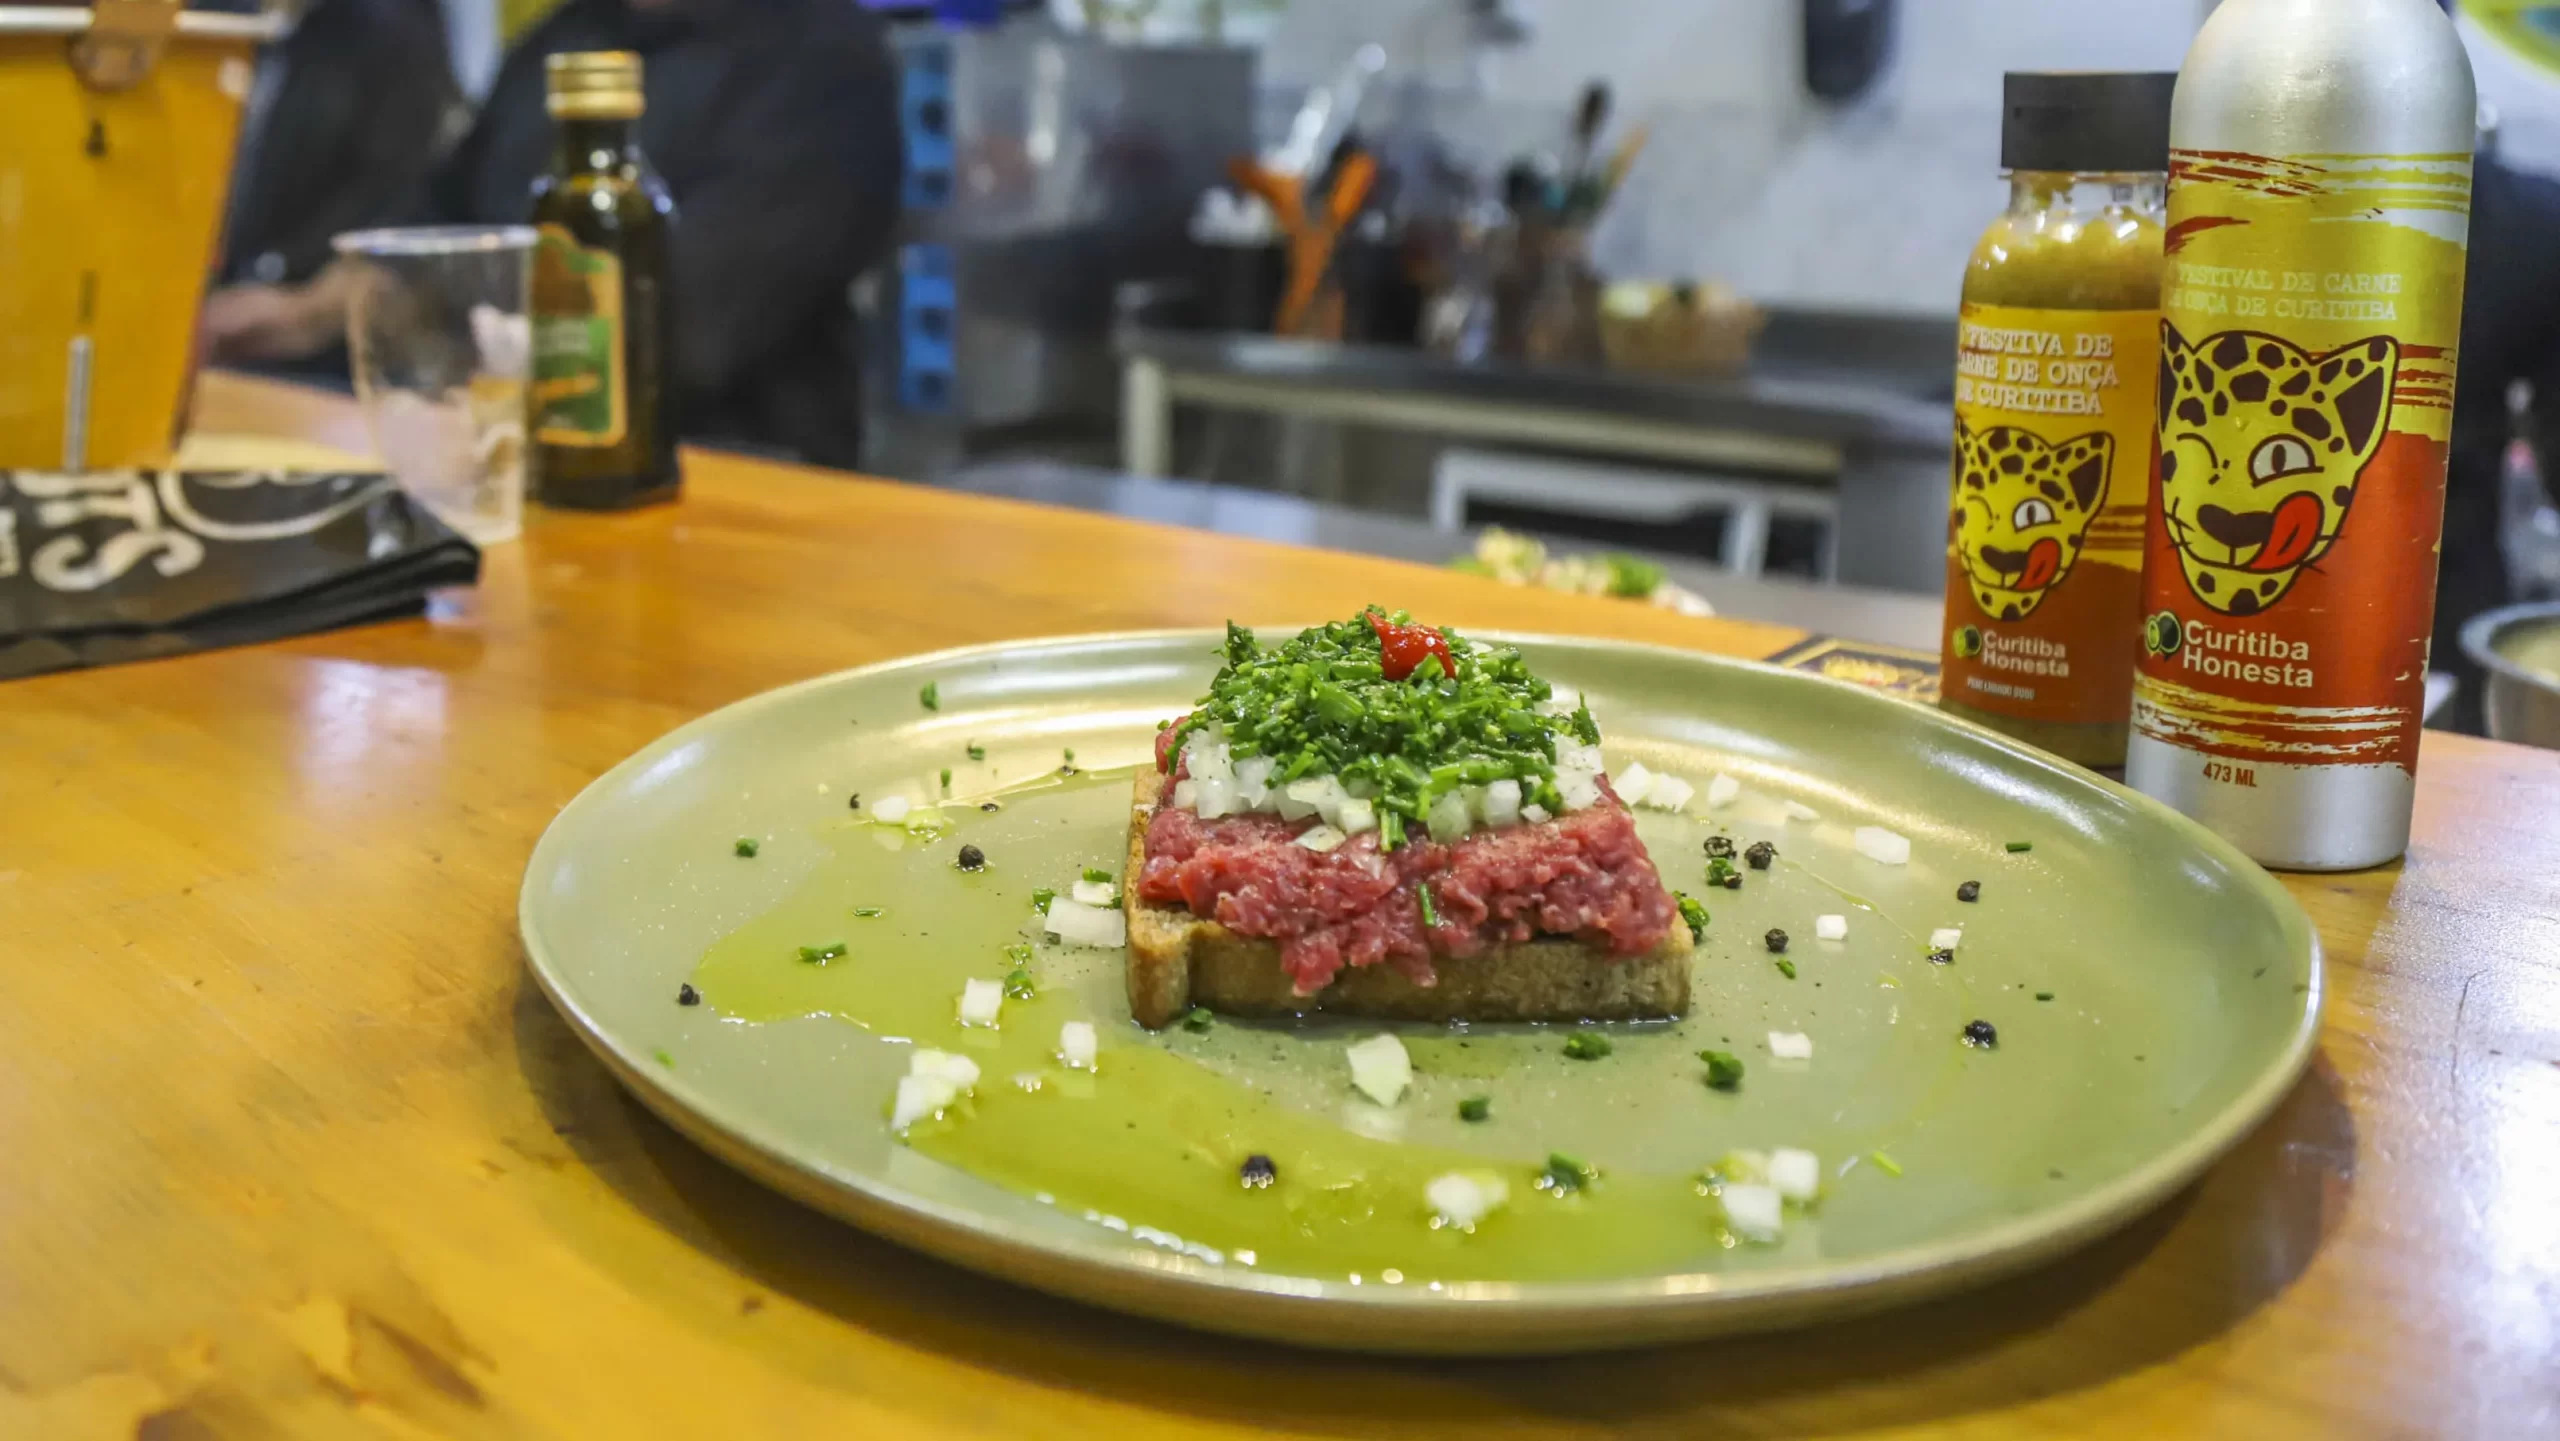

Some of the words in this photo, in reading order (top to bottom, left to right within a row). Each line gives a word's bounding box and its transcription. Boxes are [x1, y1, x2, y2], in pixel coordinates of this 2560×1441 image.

[2281, 272, 2314, 293] DE
[2323, 273, 2402, 294] CARNE
[2235, 295, 2267, 317] DE
[2275, 298, 2397, 321] CURITIBA
[2075, 333, 2112, 357] DE
[1957, 350, 1998, 378] ARNE
[2006, 357, 2039, 384] DE
[2049, 361, 2120, 389] ONÇA
[1979, 383, 2104, 415] CURITIBA
[1983, 629, 2066, 658] Curitiba
[2185, 620, 2309, 661] Curitiba
[1983, 648, 2069, 678] Honesta
[2183, 645, 2314, 688] Honesta
[2203, 761, 2232, 784] 473
[2235, 768, 2258, 788] ML
